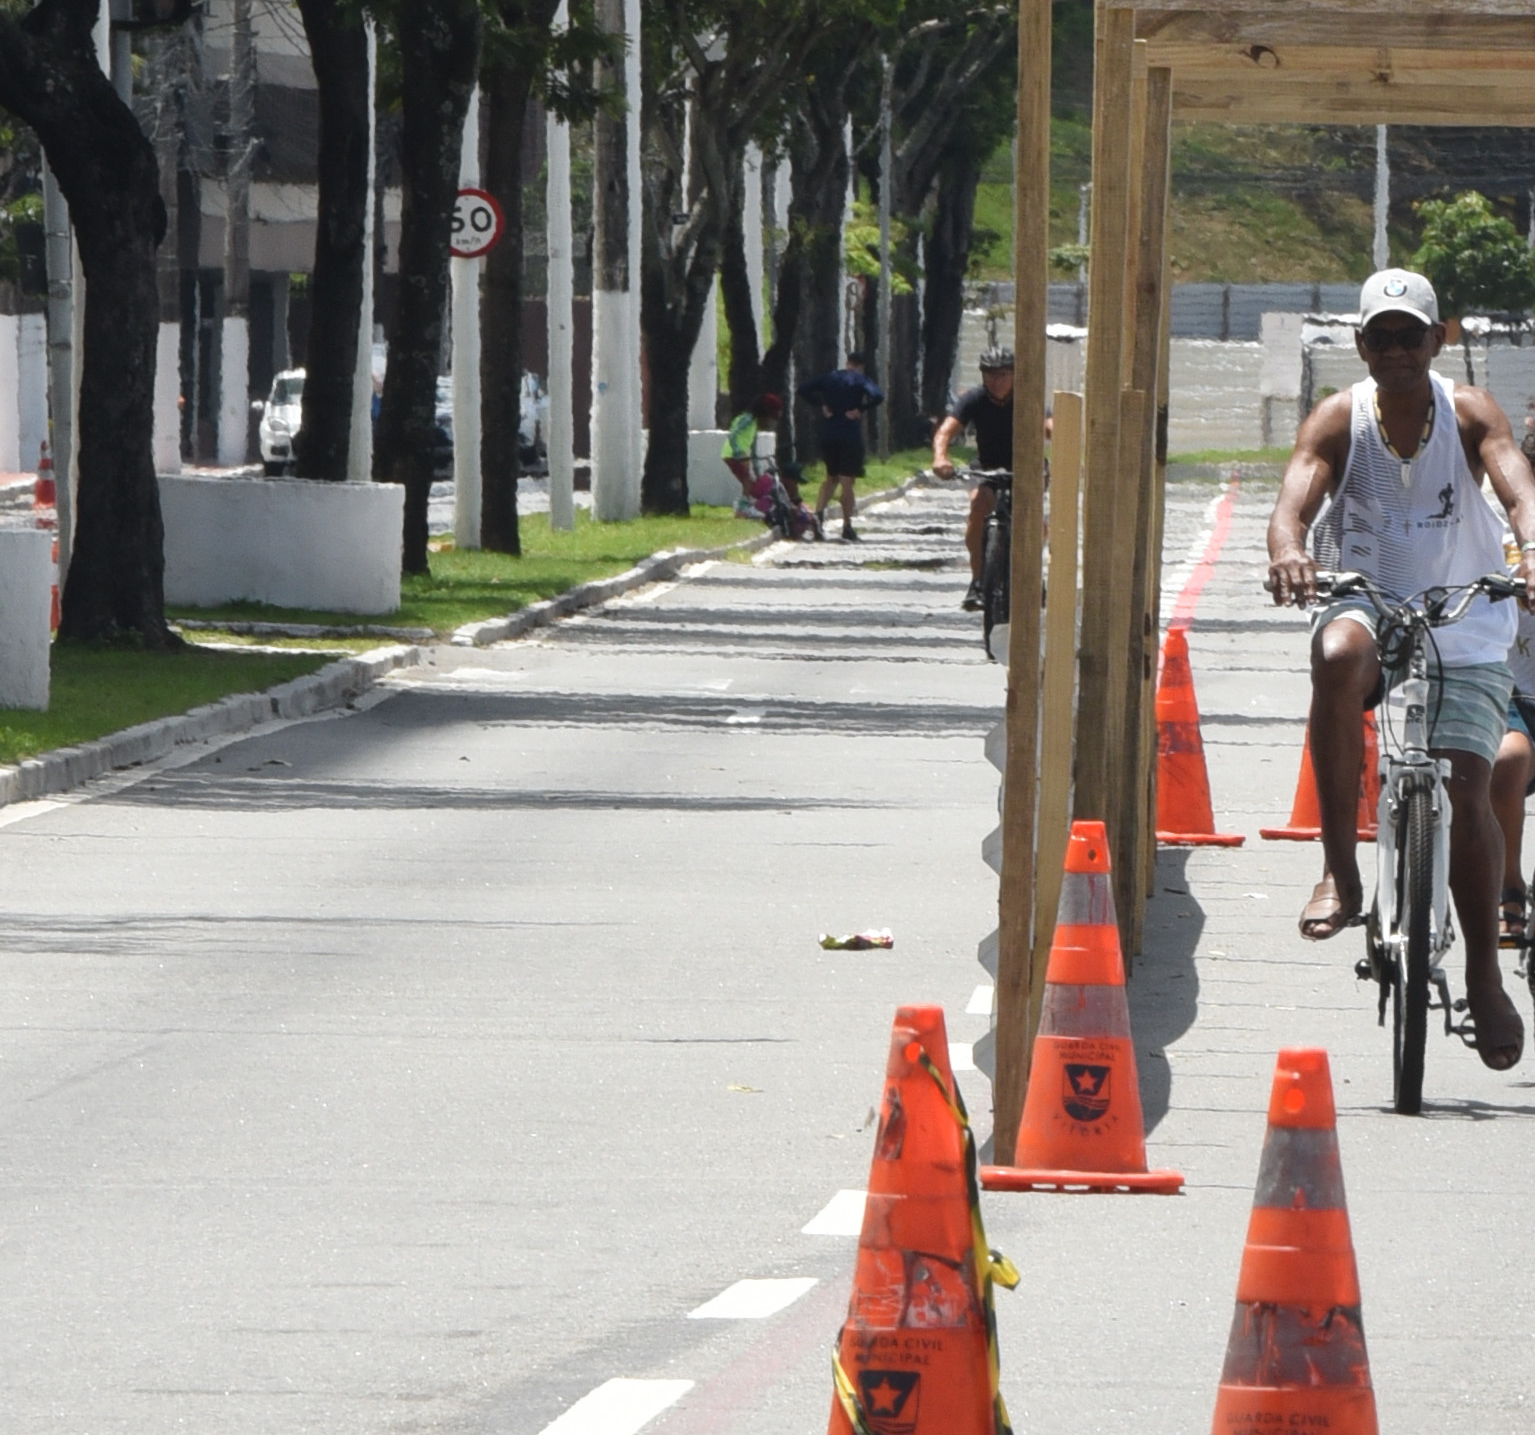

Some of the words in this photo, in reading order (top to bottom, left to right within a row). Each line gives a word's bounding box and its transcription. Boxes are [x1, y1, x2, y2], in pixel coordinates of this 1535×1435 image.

[904, 1337, 944, 1351] CIVIL
[1226, 1412, 1284, 1425] GUARDA
[1288, 1412, 1330, 1427] CIVIL
